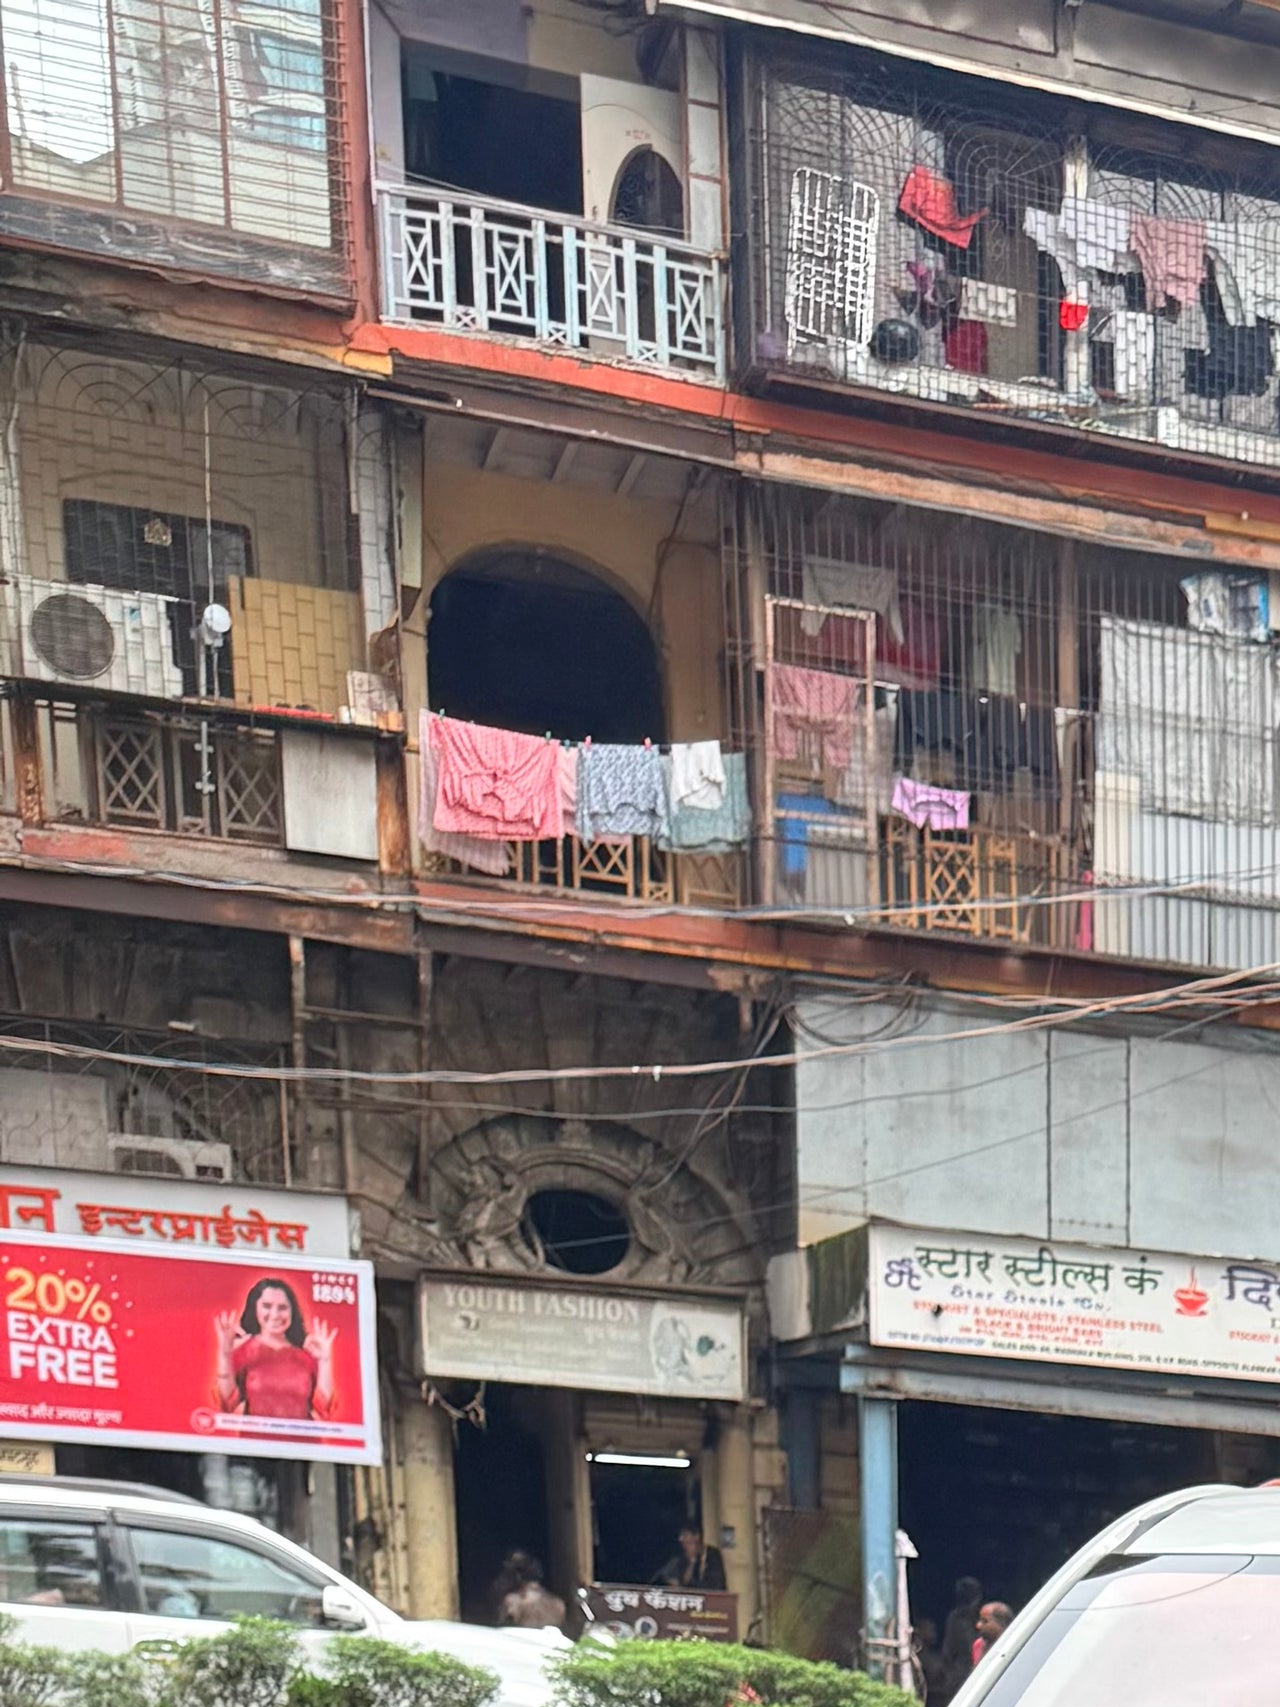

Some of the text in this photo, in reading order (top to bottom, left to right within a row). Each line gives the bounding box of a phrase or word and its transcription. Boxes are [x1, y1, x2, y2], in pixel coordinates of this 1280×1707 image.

[914, 1246, 994, 1283] स्टार
[6, 1267, 112, 1324] 20%
[443, 1285, 642, 1322] YOUTH FASHION
[7, 1311, 115, 1351] EXTRA
[10, 1343, 119, 1389] FREE
